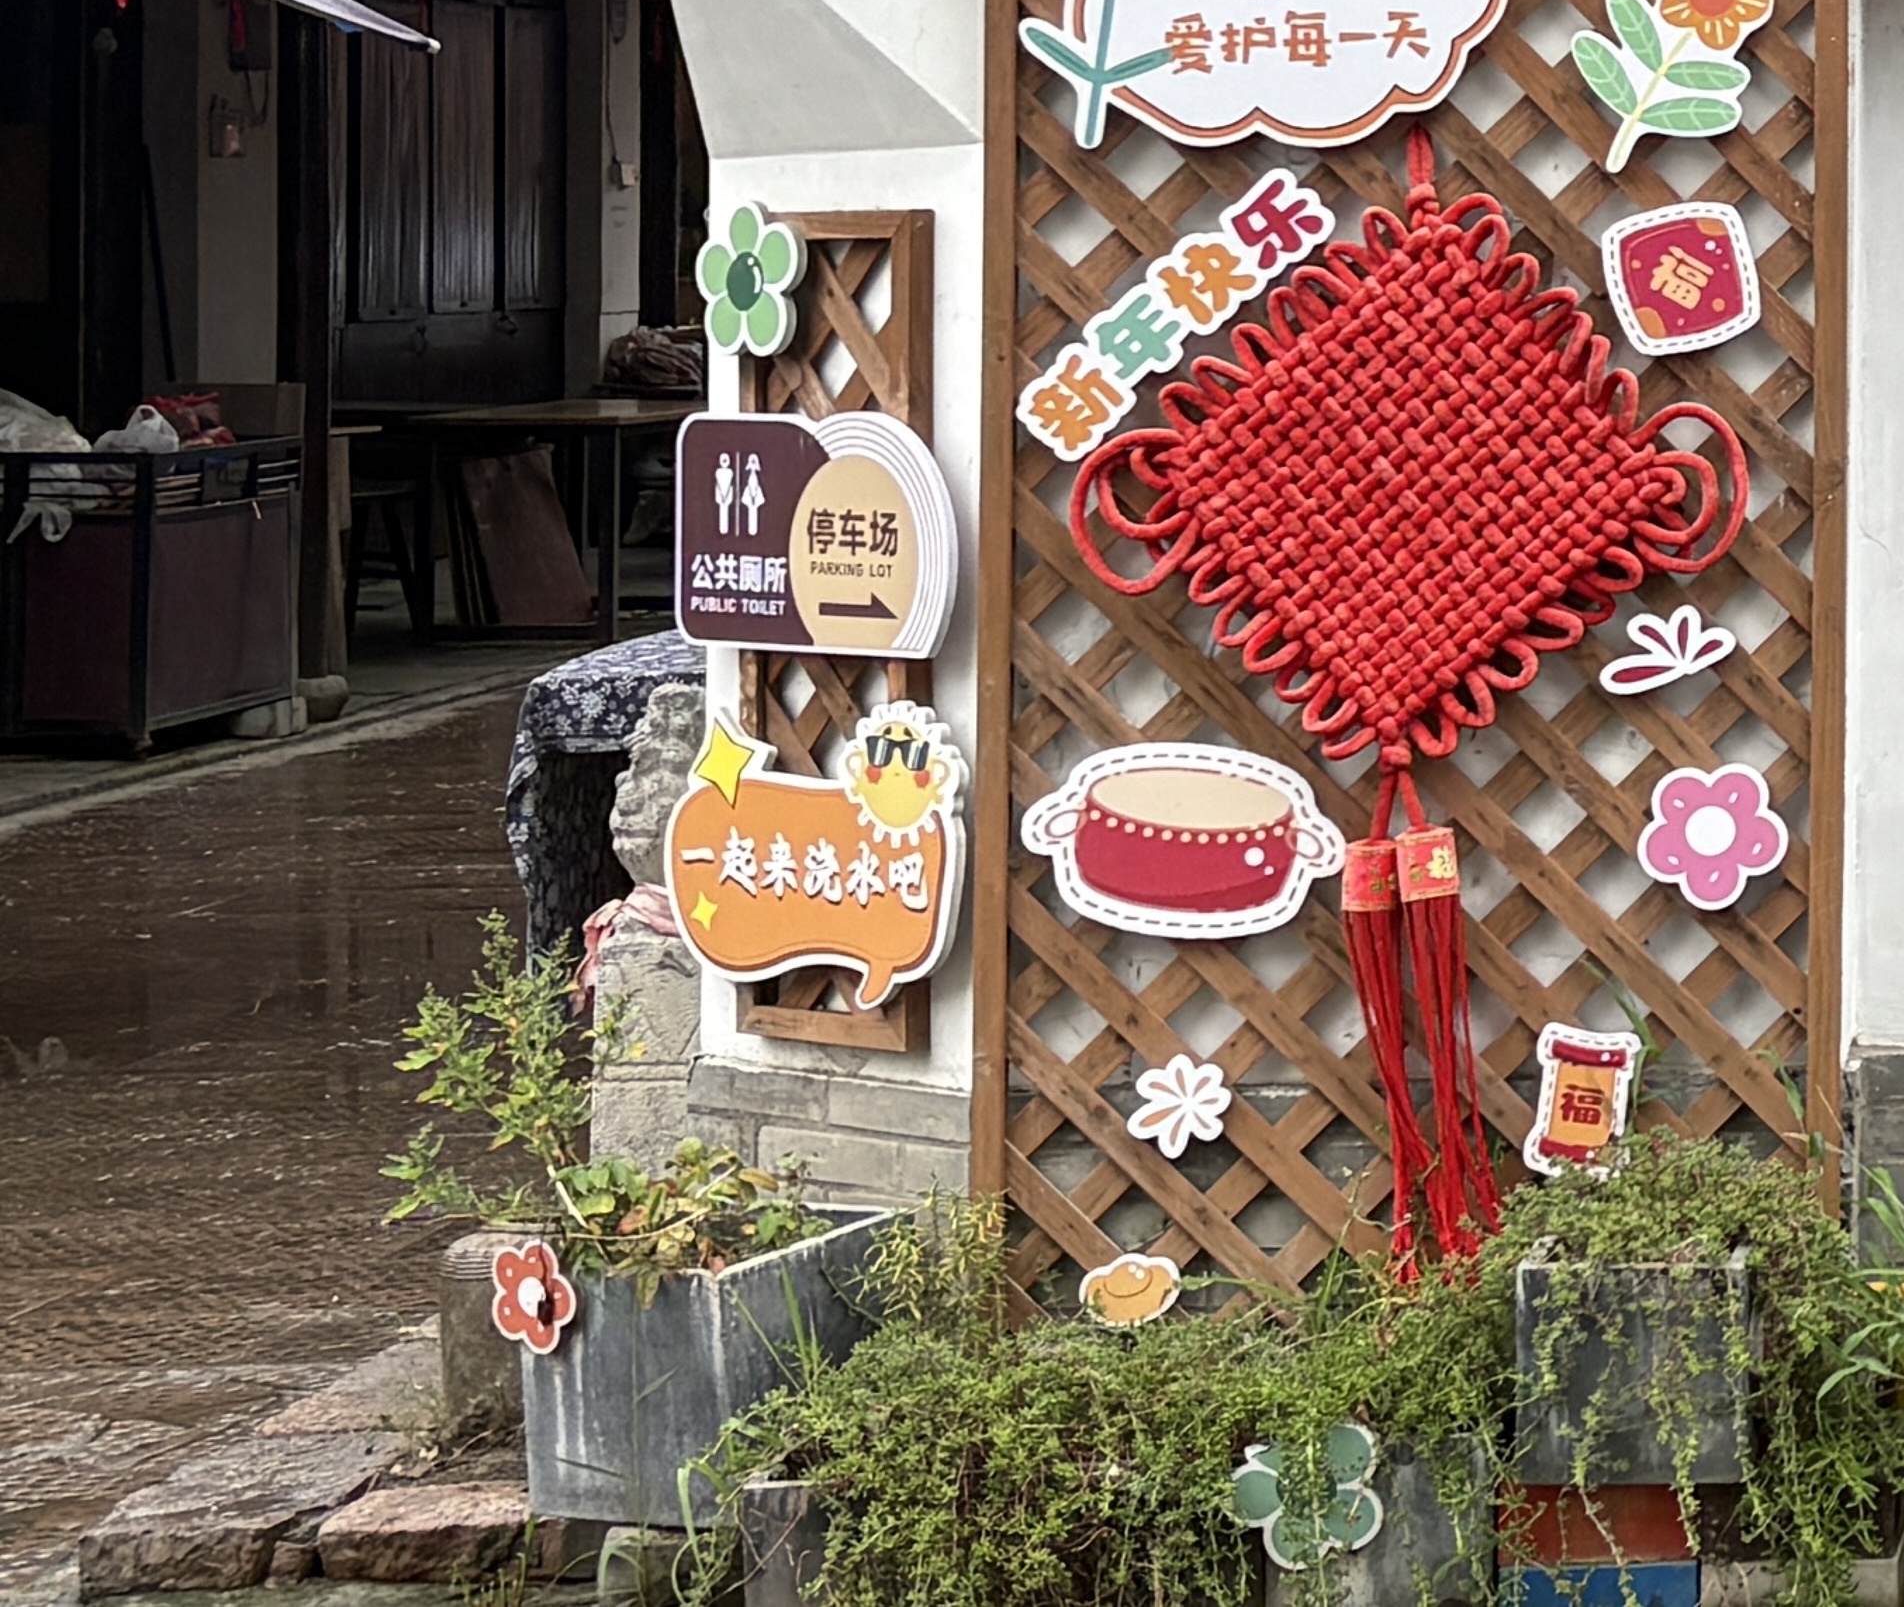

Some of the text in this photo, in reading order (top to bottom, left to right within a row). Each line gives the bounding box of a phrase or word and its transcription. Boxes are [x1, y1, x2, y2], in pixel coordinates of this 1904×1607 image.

[1163, 10, 1432, 75] 爱护每一天
[1649, 245, 1715, 312] 福
[1026, 179, 1325, 452] 新年快乐
[807, 508, 898, 557] 停车场
[691, 553, 787, 594] 公共厕所
[810, 560, 894, 578] PARKING LOT
[691, 596, 786, 615] PUBLIC TOILET
[681, 826, 929, 911] 一起来浇水吧
[1560, 1083, 1605, 1125] 福
